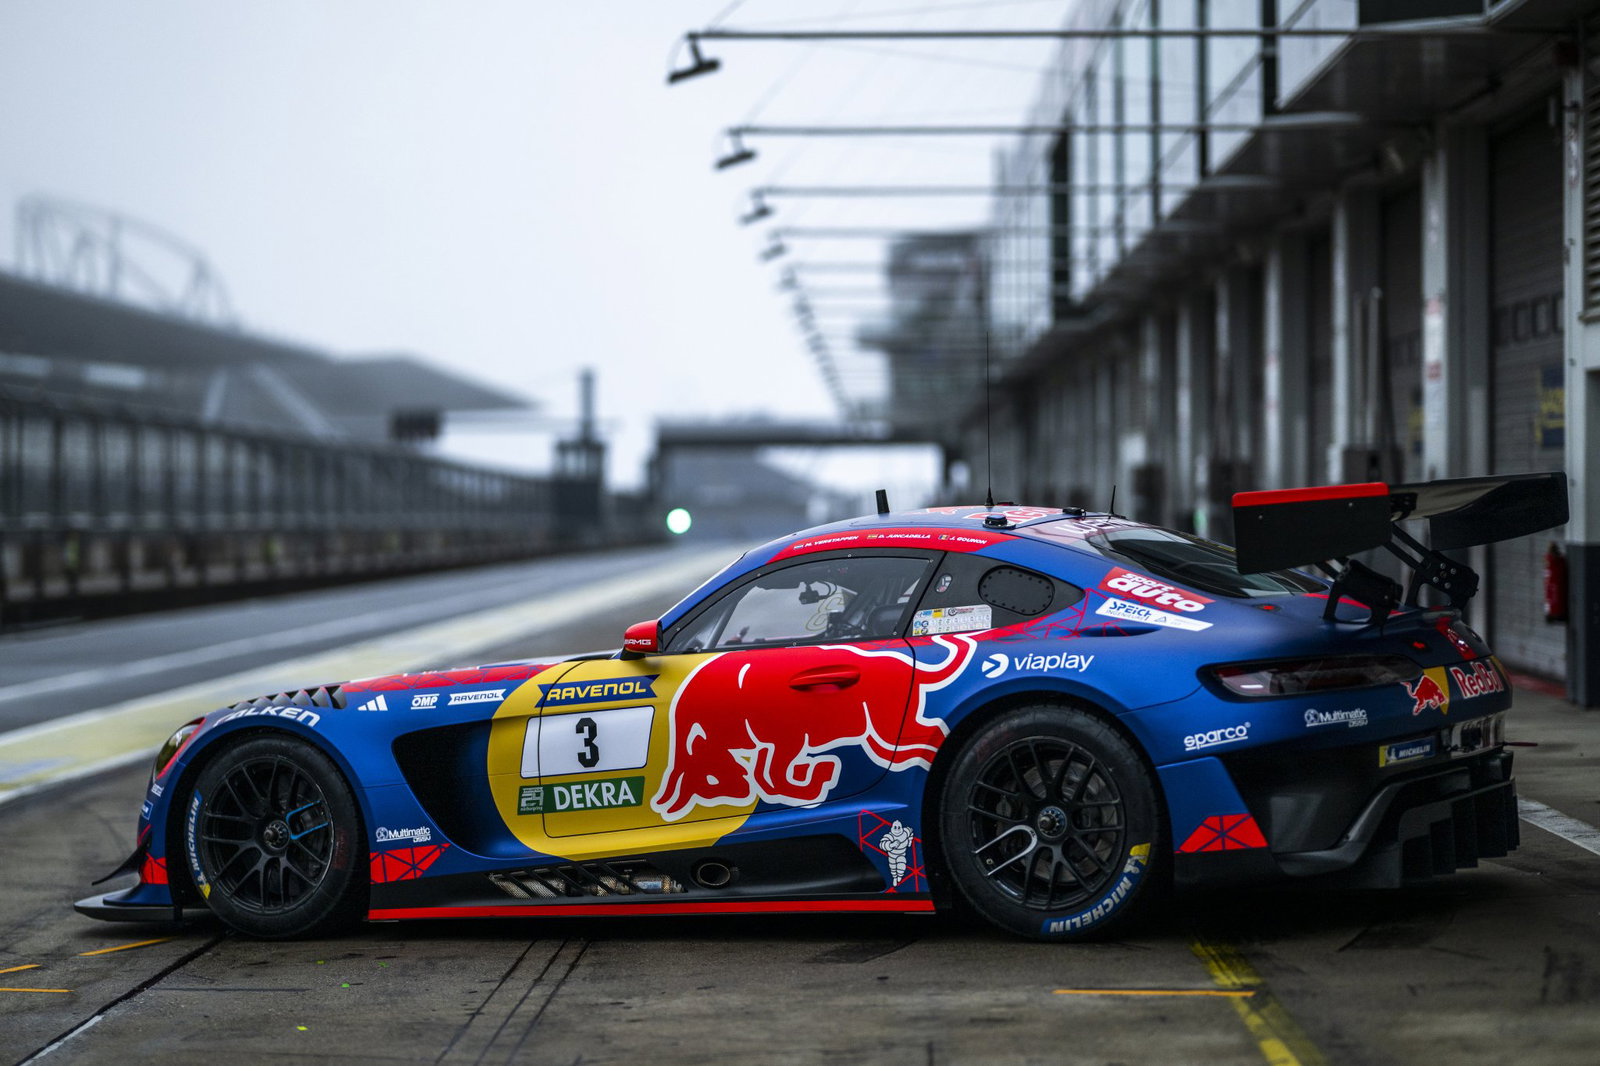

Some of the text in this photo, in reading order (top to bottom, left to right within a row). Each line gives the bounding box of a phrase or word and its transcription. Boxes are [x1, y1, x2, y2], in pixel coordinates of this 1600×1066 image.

[1121, 573, 1175, 592] sport
[1107, 577, 1205, 612] auto
[1014, 652, 1095, 673] viaplay
[411, 695, 438, 708] OMP
[453, 692, 500, 702] RAVENOL
[546, 681, 647, 702] RAVENOL
[213, 706, 321, 728] FALKEN
[1320, 708, 1367, 722] Multimatic
[575, 717, 600, 768] 3
[1184, 725, 1248, 750] sparco
[1398, 744, 1431, 758] MICHELIN
[553, 780, 636, 810] DEKRA
[187, 797, 201, 871] MICHELIN
[388, 826, 431, 839] Multimatic
[1049, 876, 1133, 933] MICHELIN
